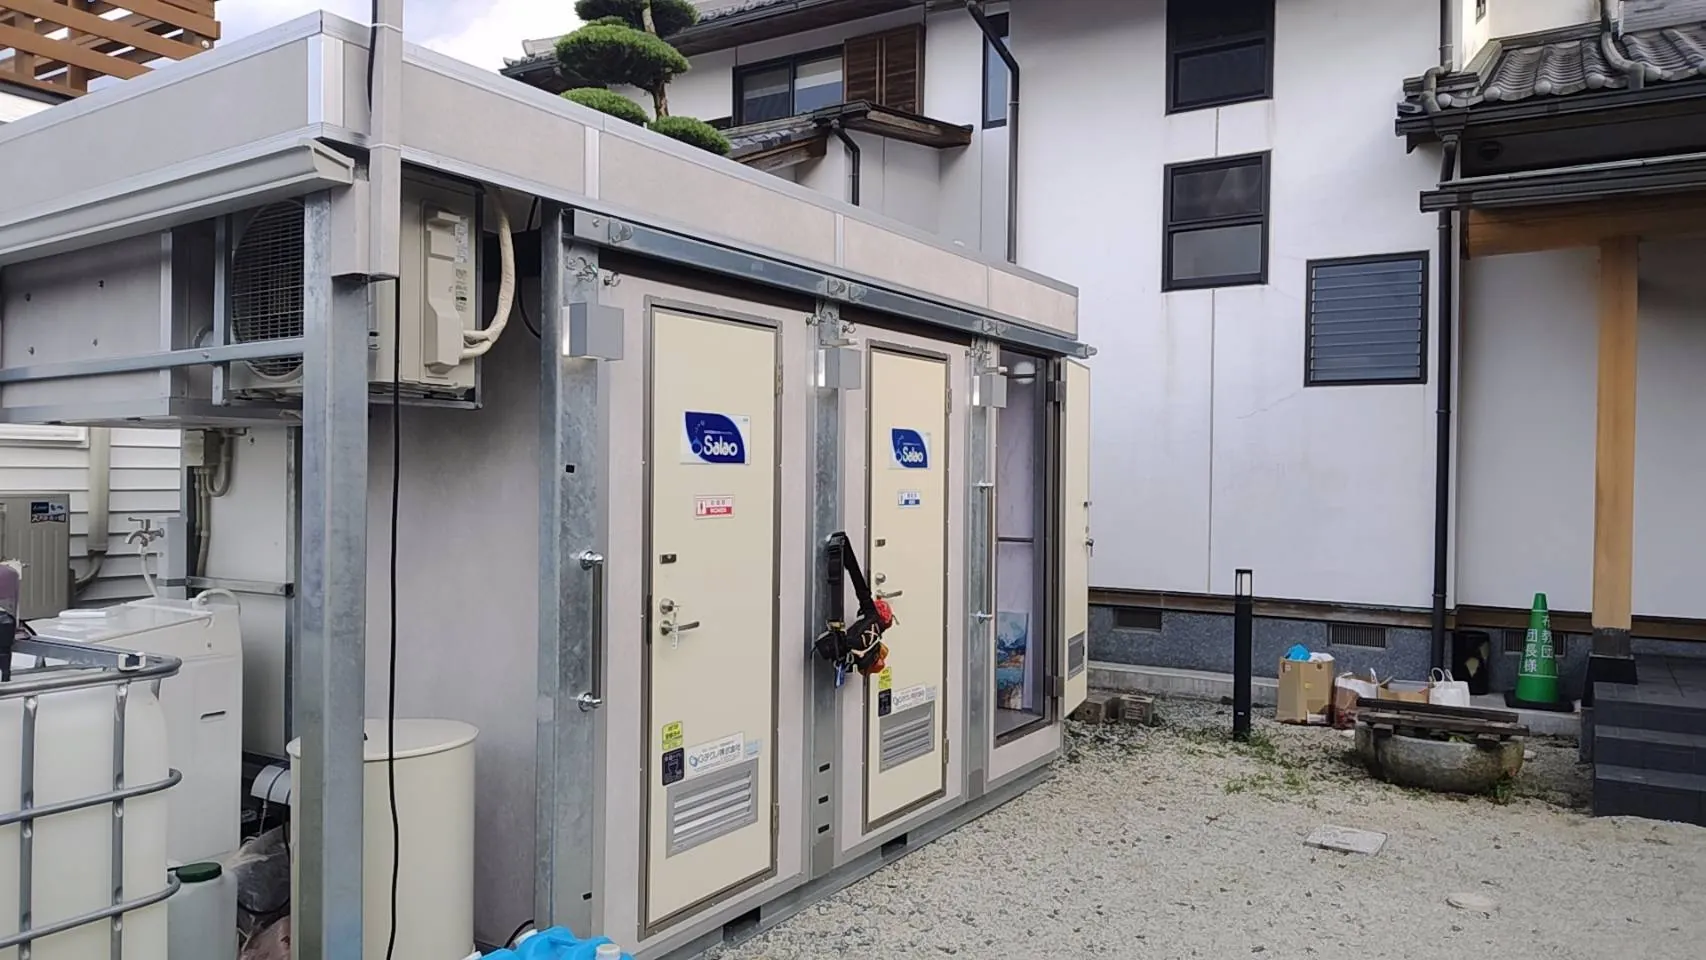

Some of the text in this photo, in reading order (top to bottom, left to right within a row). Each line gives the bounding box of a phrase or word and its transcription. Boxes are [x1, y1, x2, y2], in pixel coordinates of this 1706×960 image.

[703, 434, 738, 456] Salao
[1524, 628, 1538, 673] 団長様
